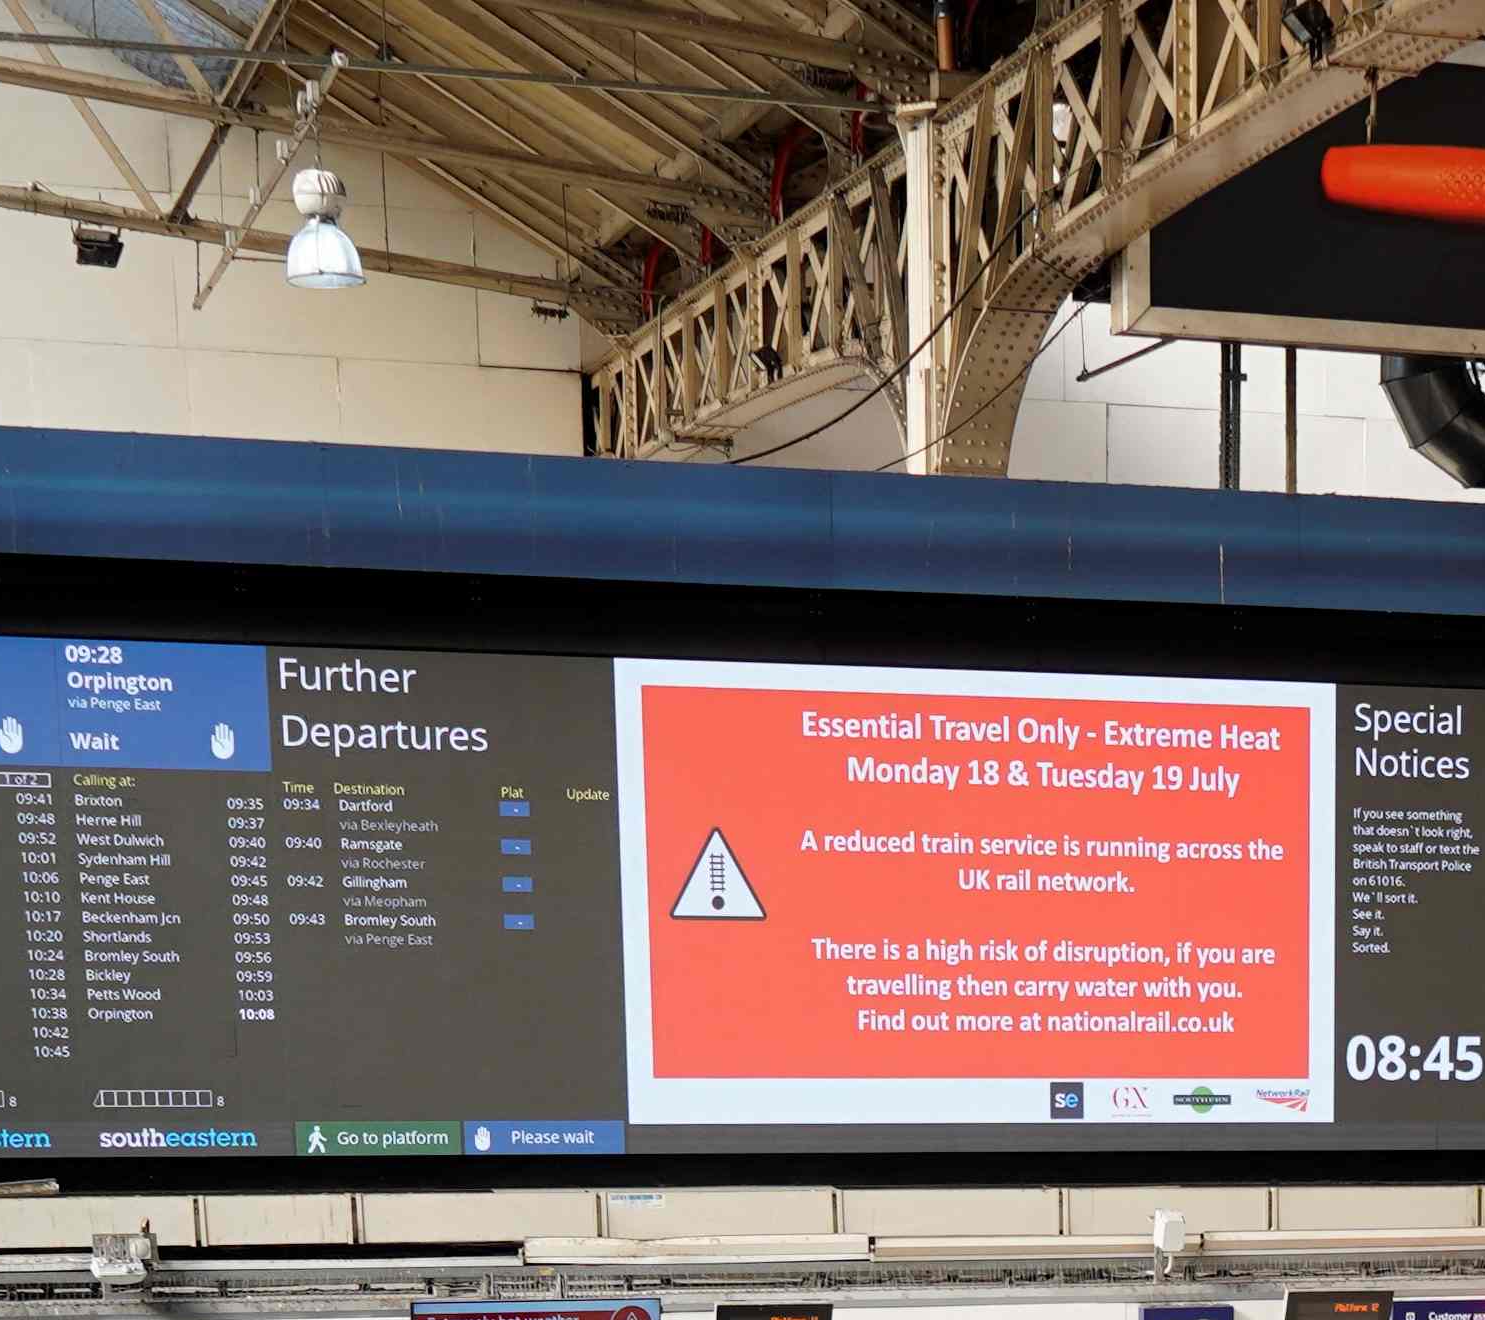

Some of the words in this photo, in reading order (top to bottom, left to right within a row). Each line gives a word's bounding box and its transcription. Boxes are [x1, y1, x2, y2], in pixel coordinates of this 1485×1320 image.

[279, 657, 417, 693] Further
[282, 715, 488, 757] Departures
[802, 711, 922, 739] Essential
[929, 715, 1010, 742] Travel
[1017, 717, 1080, 751] Only
[1105, 720, 1212, 748] Extreme
[1220, 724, 1280, 751] Heat
[1355, 703, 1462, 741] Special
[1356, 747, 1469, 779] Notices
[282, 781, 314, 794] Time
[334, 782, 405, 795] Destination
[501, 786, 524, 799] Plat
[567, 788, 610, 802] Update
[1352, 877, 1367, 886] on
[1368, 875, 1405, 887] 61016.
[1353, 858, 1387, 870] British
[1388, 859, 1439, 873] Transport
[1441, 860, 1472, 872] Police
[1047, 1011, 1234, 1032] nationalrail.co.uk
[1346, 1035, 1483, 1081] 08:45
